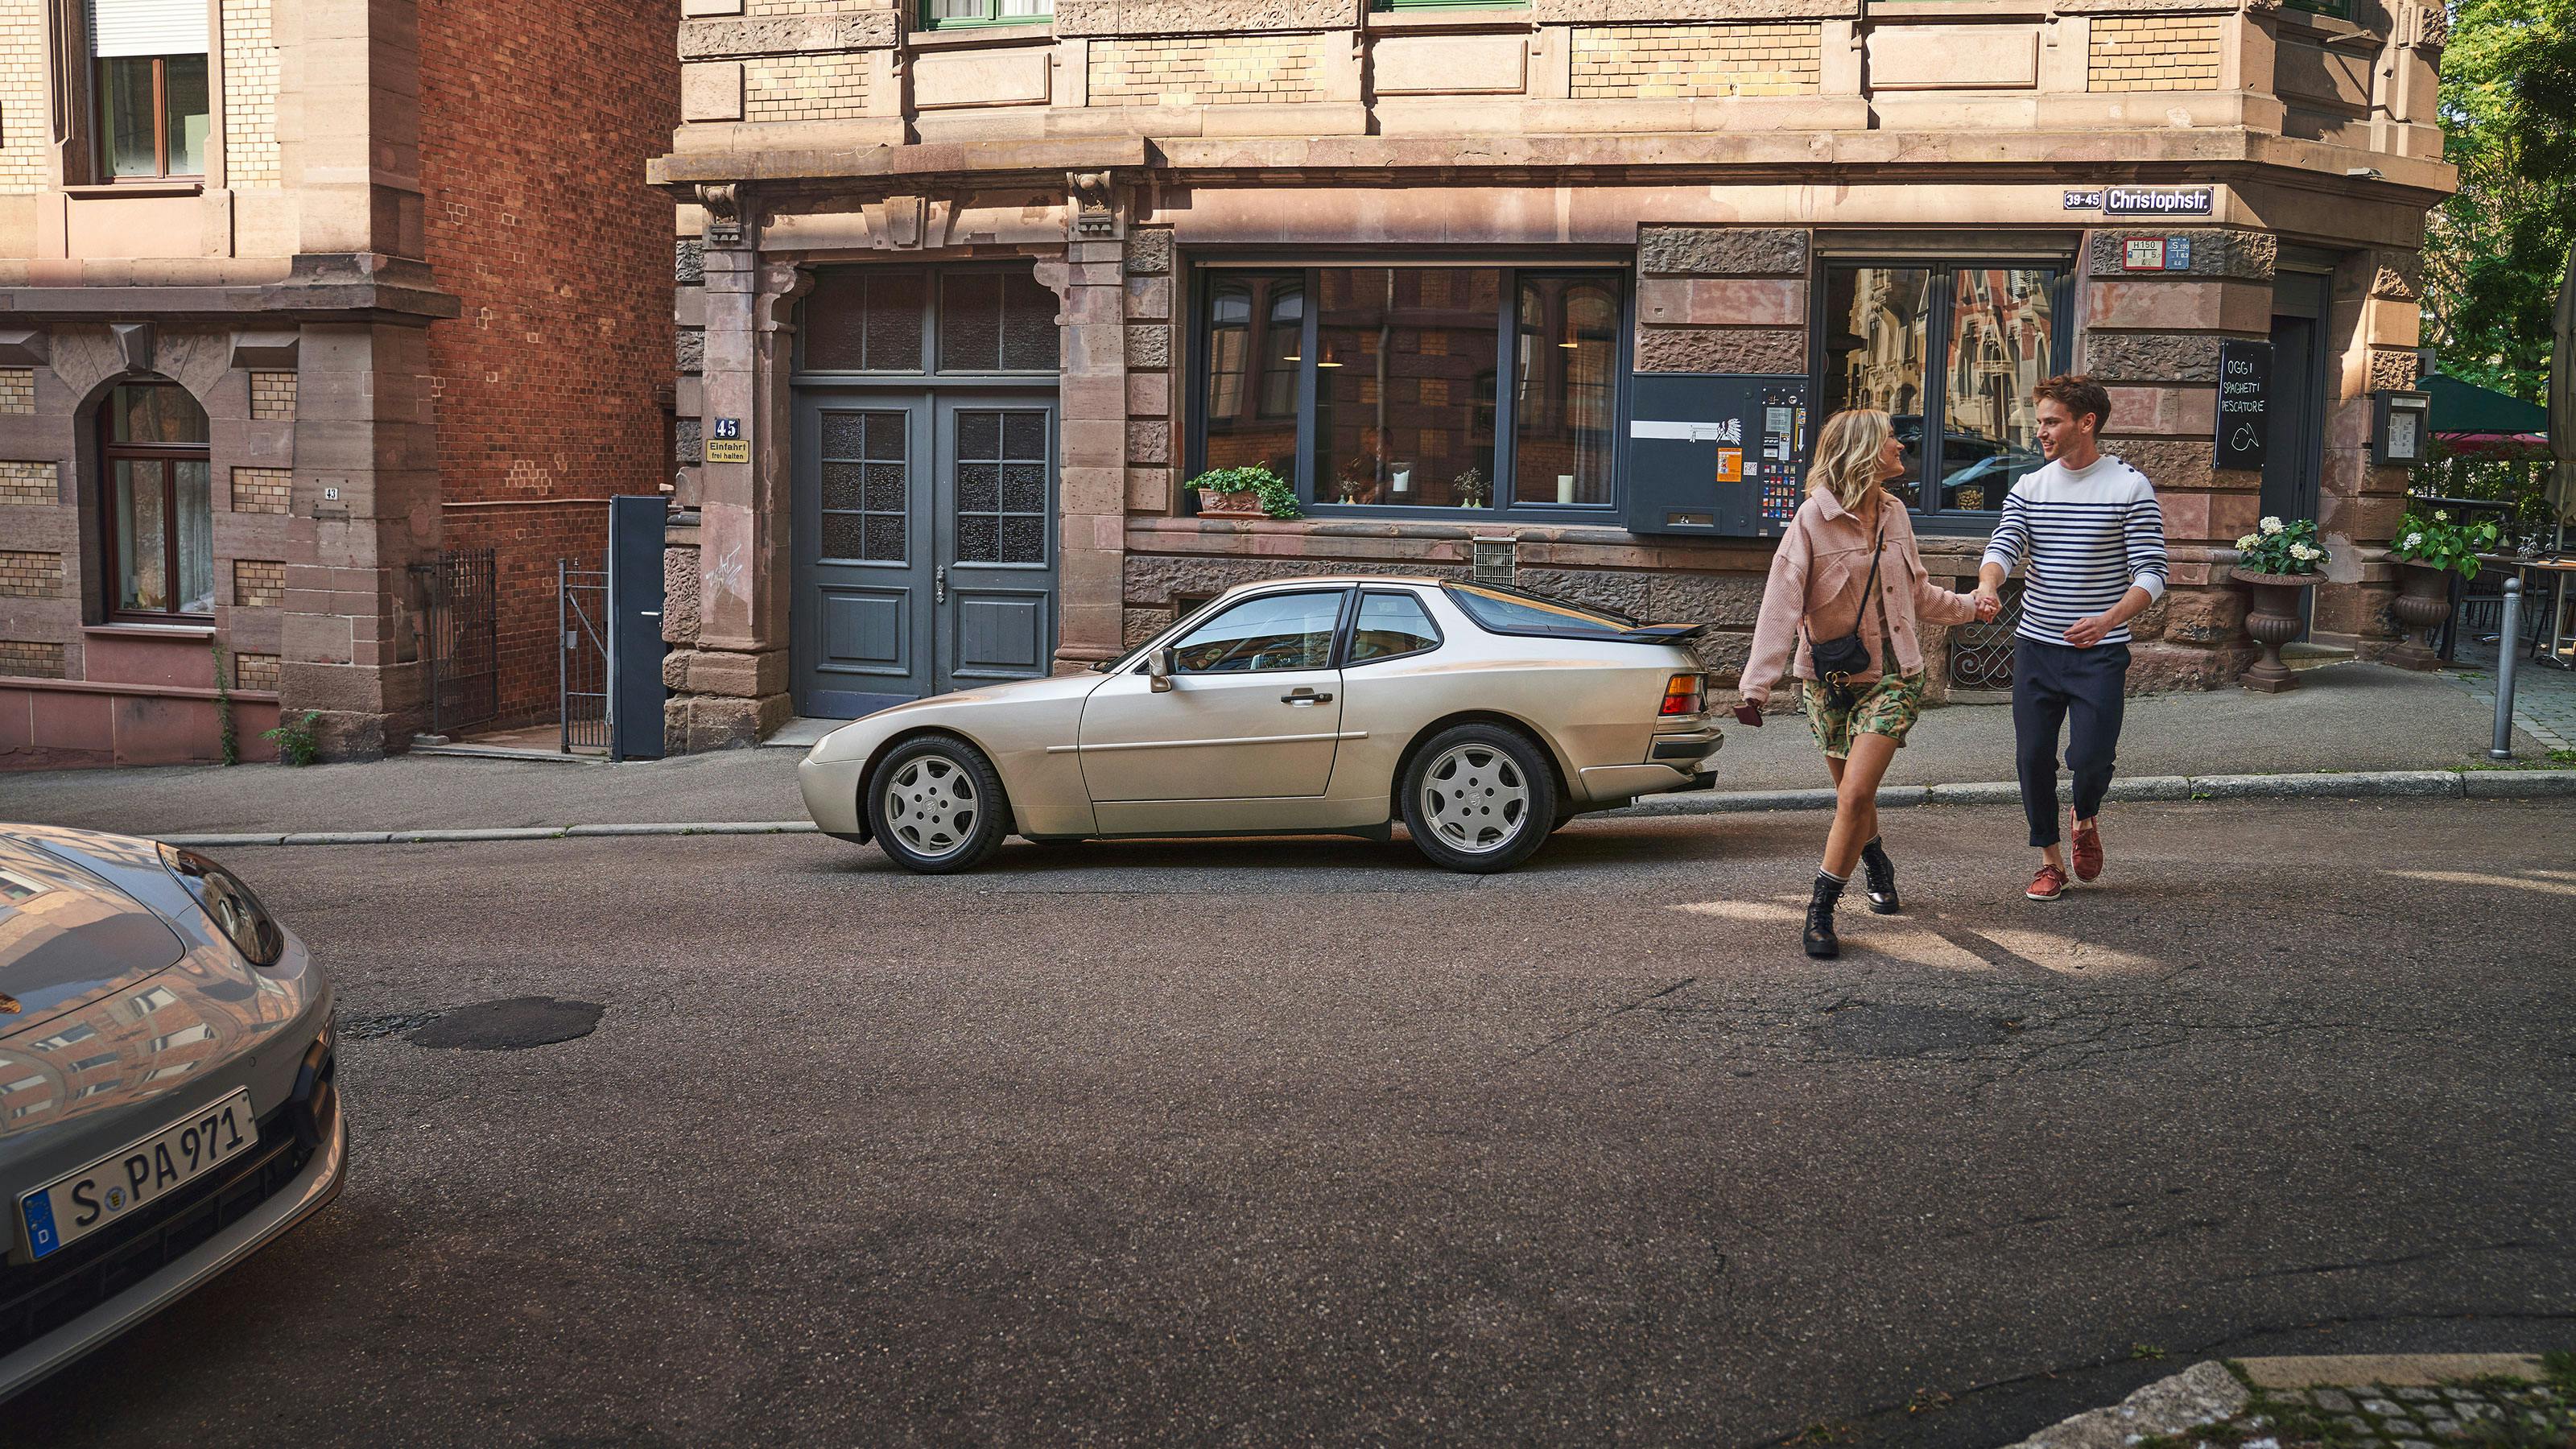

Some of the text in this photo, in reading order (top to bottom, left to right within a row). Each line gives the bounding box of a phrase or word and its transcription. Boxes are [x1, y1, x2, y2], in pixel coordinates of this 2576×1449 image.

[2066, 194, 2100, 206] 39-45
[2110, 190, 2208, 212] Christophstr.
[2172, 242, 2178, 250] S
[2227, 360, 2252, 375] OGGI
[2223, 381, 2260, 394] SPAGHETTI
[2221, 400, 2264, 413] PESCATORE
[716, 420, 736, 436] 45
[709, 442, 746, 452] Einfahrt
[724, 452, 744, 460] halten
[327, 489, 336, 498] 43
[71, 1105, 244, 1227] S PA 971
[38, 1228, 49, 1244] D
